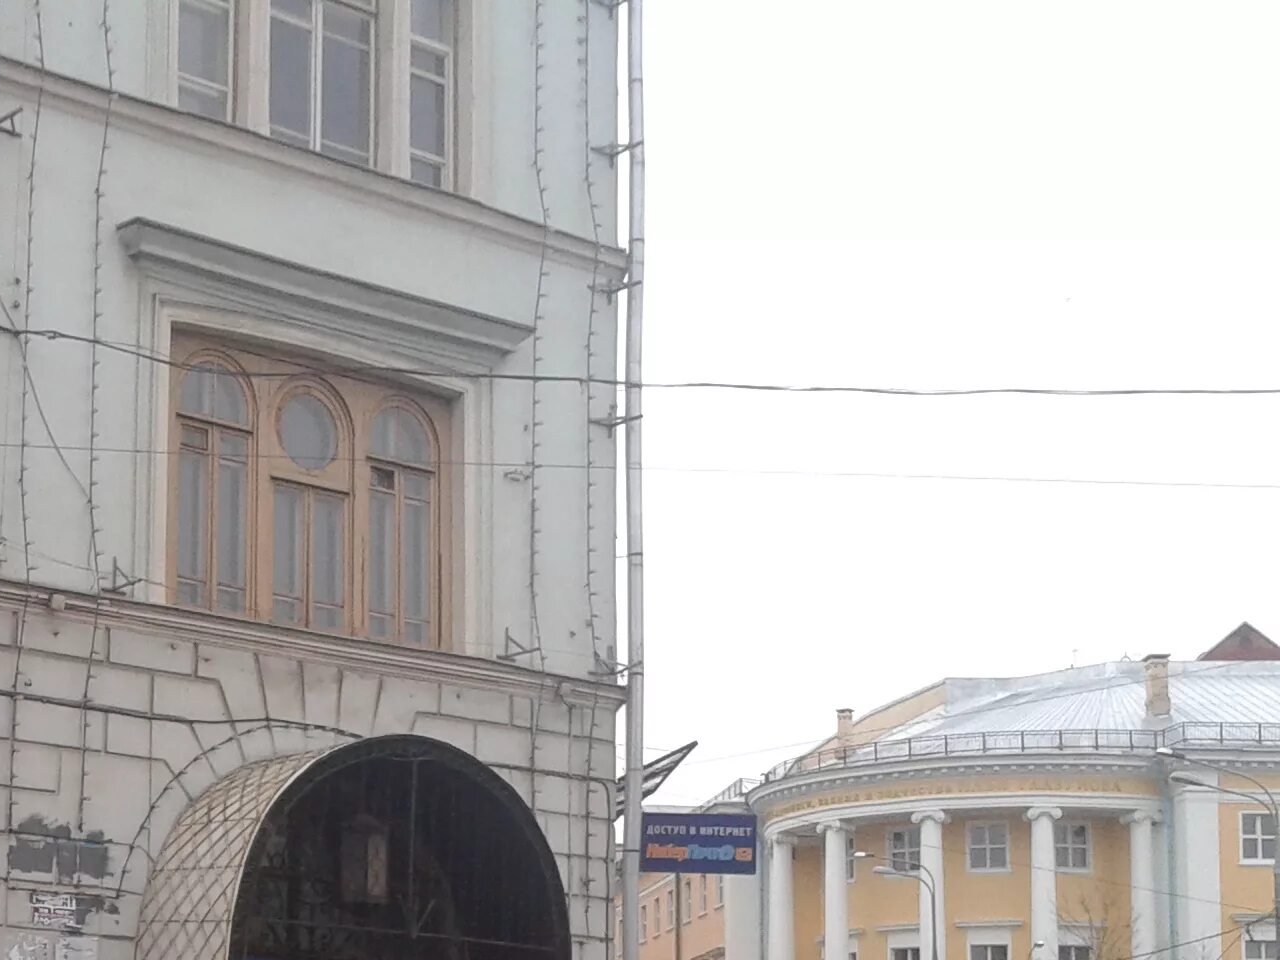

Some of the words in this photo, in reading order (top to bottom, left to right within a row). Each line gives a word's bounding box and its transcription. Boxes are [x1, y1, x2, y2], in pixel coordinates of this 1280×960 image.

[646, 825, 687, 835] ДОСТУП
[689, 826, 697, 835] В
[699, 826, 753, 837] ИНТЕРНЕТ
